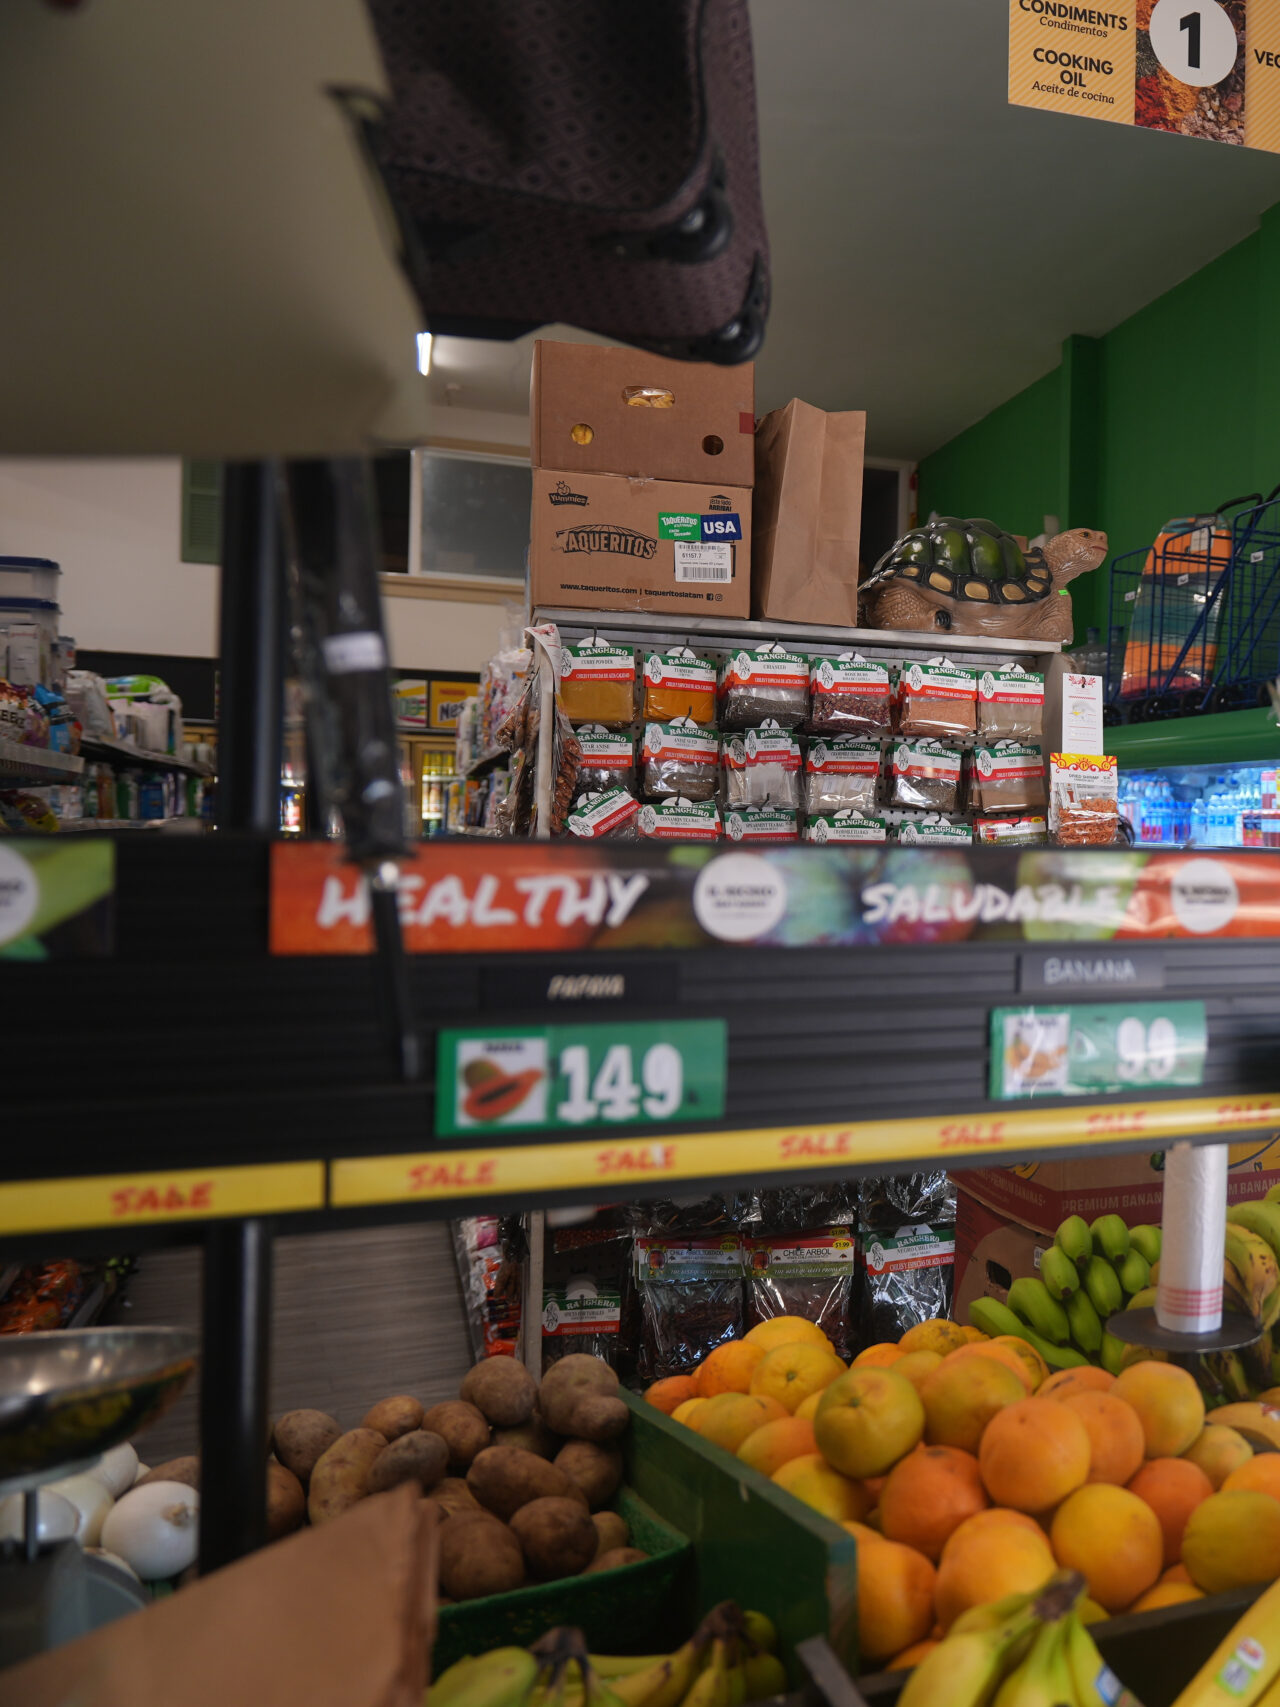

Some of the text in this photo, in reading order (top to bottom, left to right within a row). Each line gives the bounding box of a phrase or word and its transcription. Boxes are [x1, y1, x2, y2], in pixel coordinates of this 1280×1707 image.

[1019, 0, 1128, 31] CONDIMENTS
[1039, 16, 1108, 38] Condimentos
[1179, 11, 1201, 69] 1
[1033, 47, 1114, 76] COOKING
[1060, 70, 1087, 88] OIL
[1031, 81, 1115, 105] Aceite de cocina
[703, 520, 737, 534] USA
[560, 583, 704, 600] www.taqueritos.com taqueritoslatam
[319, 872, 650, 928] HEALTHY
[1043, 958, 1137, 986] BANANA
[1115, 1017, 1177, 1079] 99
[555, 1043, 684, 1123] 149
[779, 1129, 855, 1162] SALE
[939, 1122, 1007, 1149] SALE
[408, 1159, 497, 1192] SALE
[1062, 1192, 1120, 1214] PREMIUM
[783, 1248, 832, 1257] CHILE ARBOL
[834, 1241, 850, 1249] $1.99
